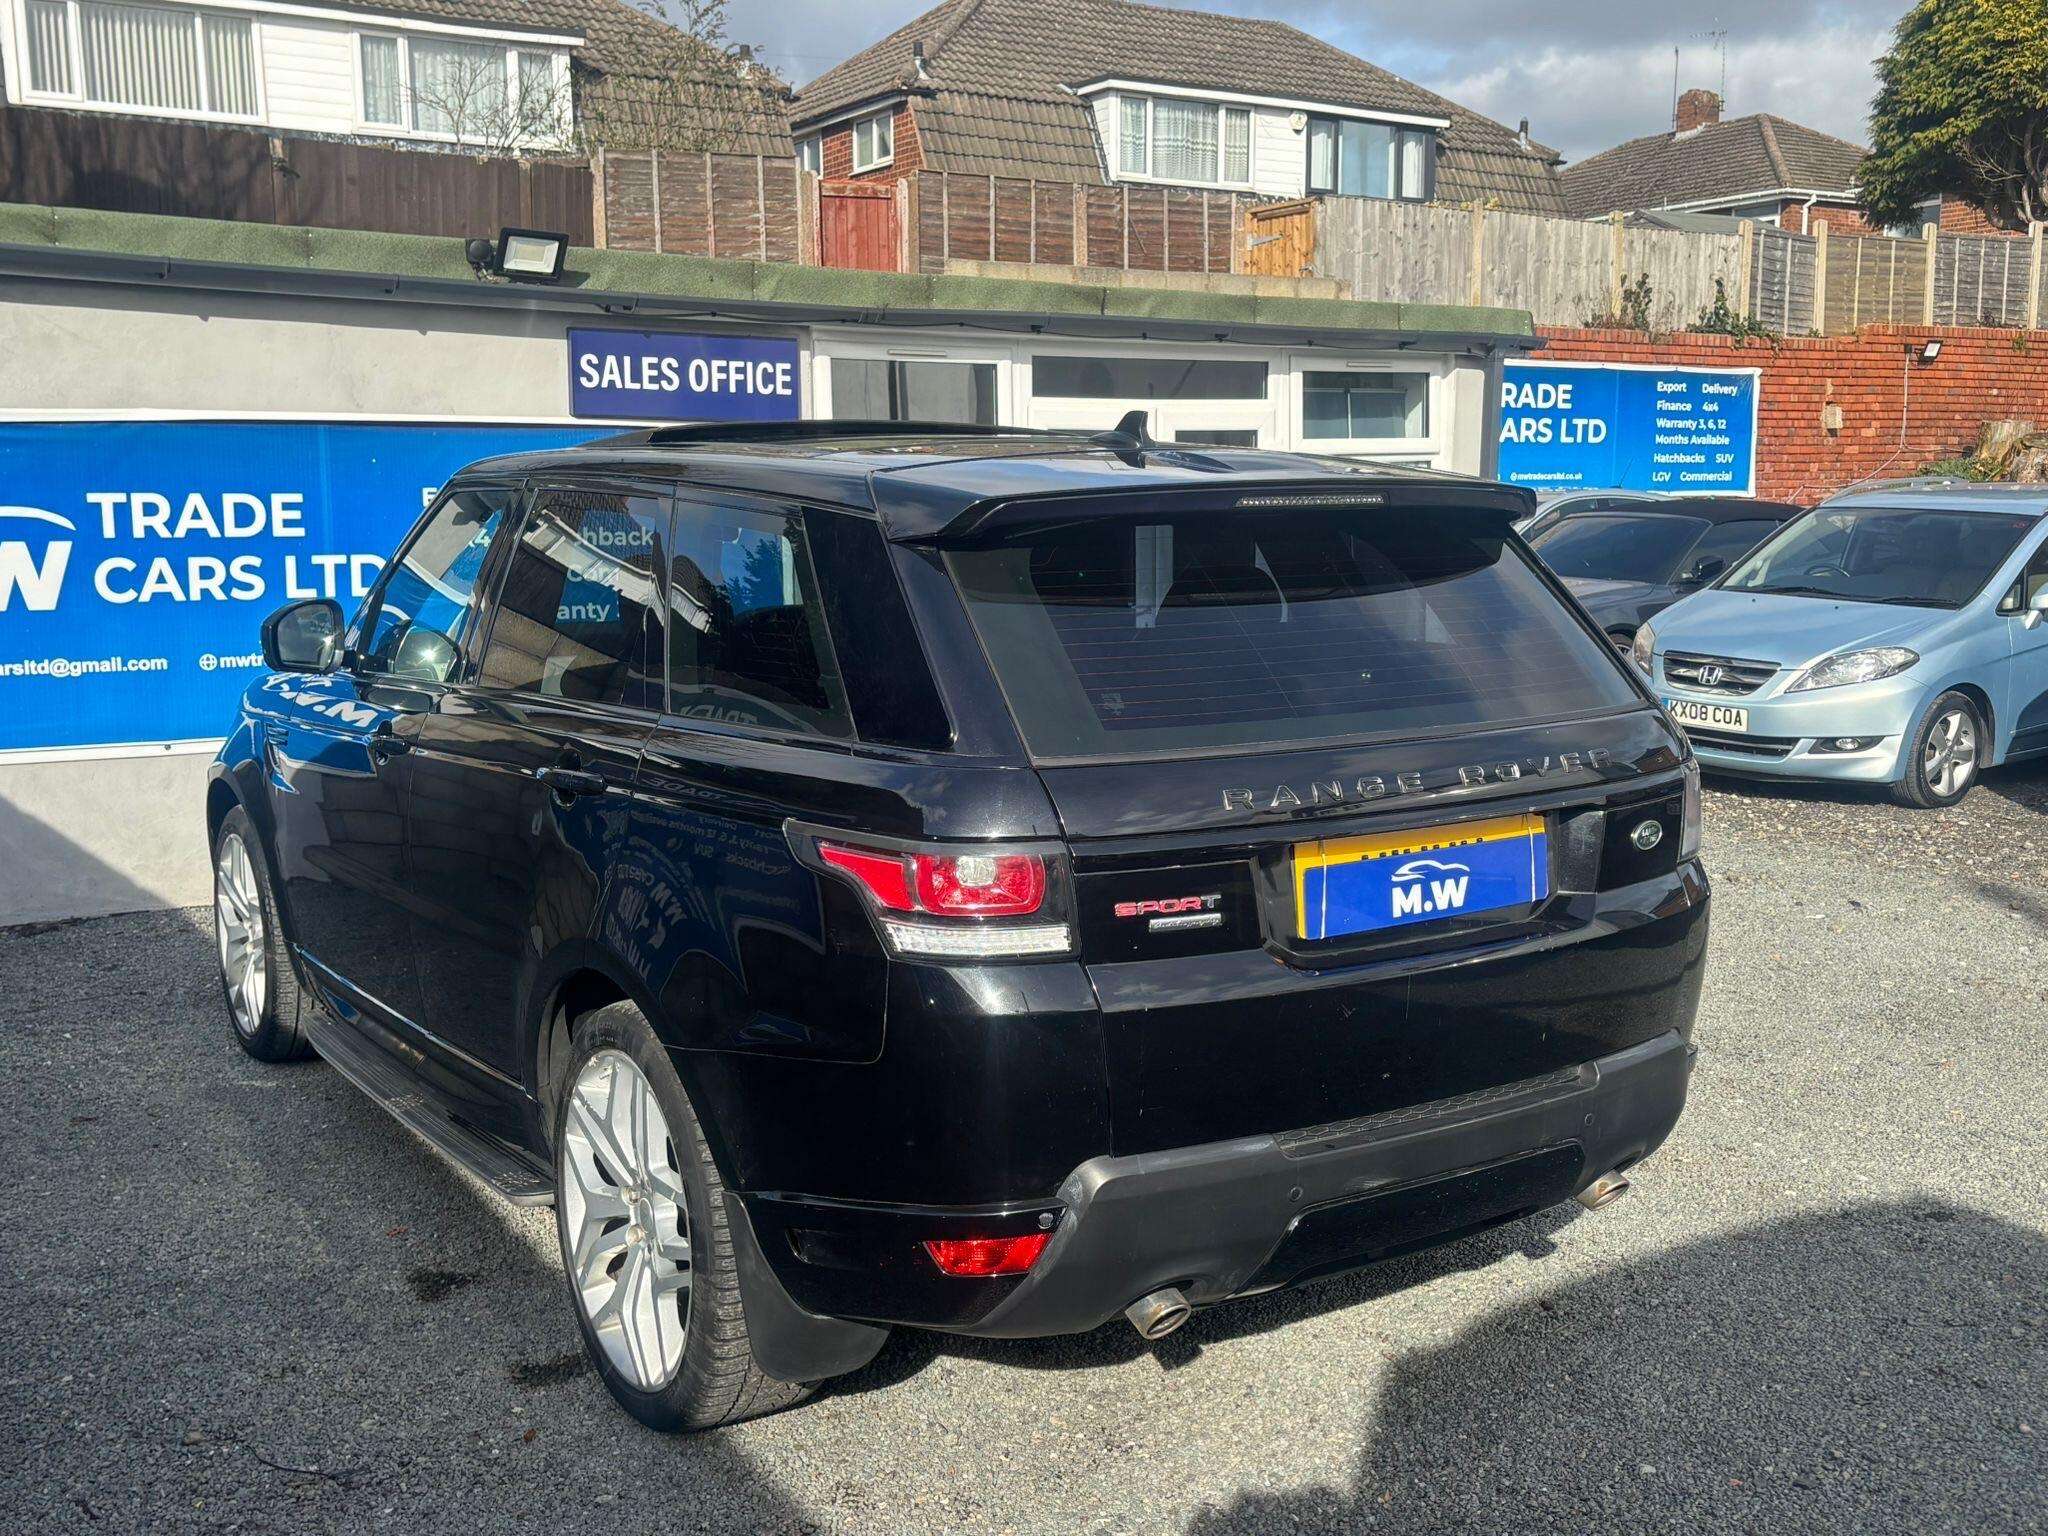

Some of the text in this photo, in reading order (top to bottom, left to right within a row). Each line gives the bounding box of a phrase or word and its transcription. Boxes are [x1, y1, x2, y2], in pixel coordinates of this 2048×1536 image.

[579, 353, 793, 396] SALES OFFICE
[1500, 382, 1573, 409] RADE
[1657, 381, 1738, 397] Export Delivery
[1656, 400, 1719, 412] Finance 4x4
[1499, 417, 1607, 443] ARS LTD
[1656, 418, 1697, 431] Warranty
[1717, 418, 1727, 430] 12
[1655, 434, 1730, 445] Months Available
[1653, 452, 1735, 464] Hatchbacks SUV
[1652, 471, 1733, 482] LGV Commercial
[86, 492, 306, 539] TRADE
[94, 554, 388, 604] CARS LTD
[1670, 701, 1742, 726] KX08 COA
[1221, 747, 1611, 812] RANGE ROVER
[1114, 894, 1221, 917] SPORT
[1392, 876, 1469, 918] M.W
